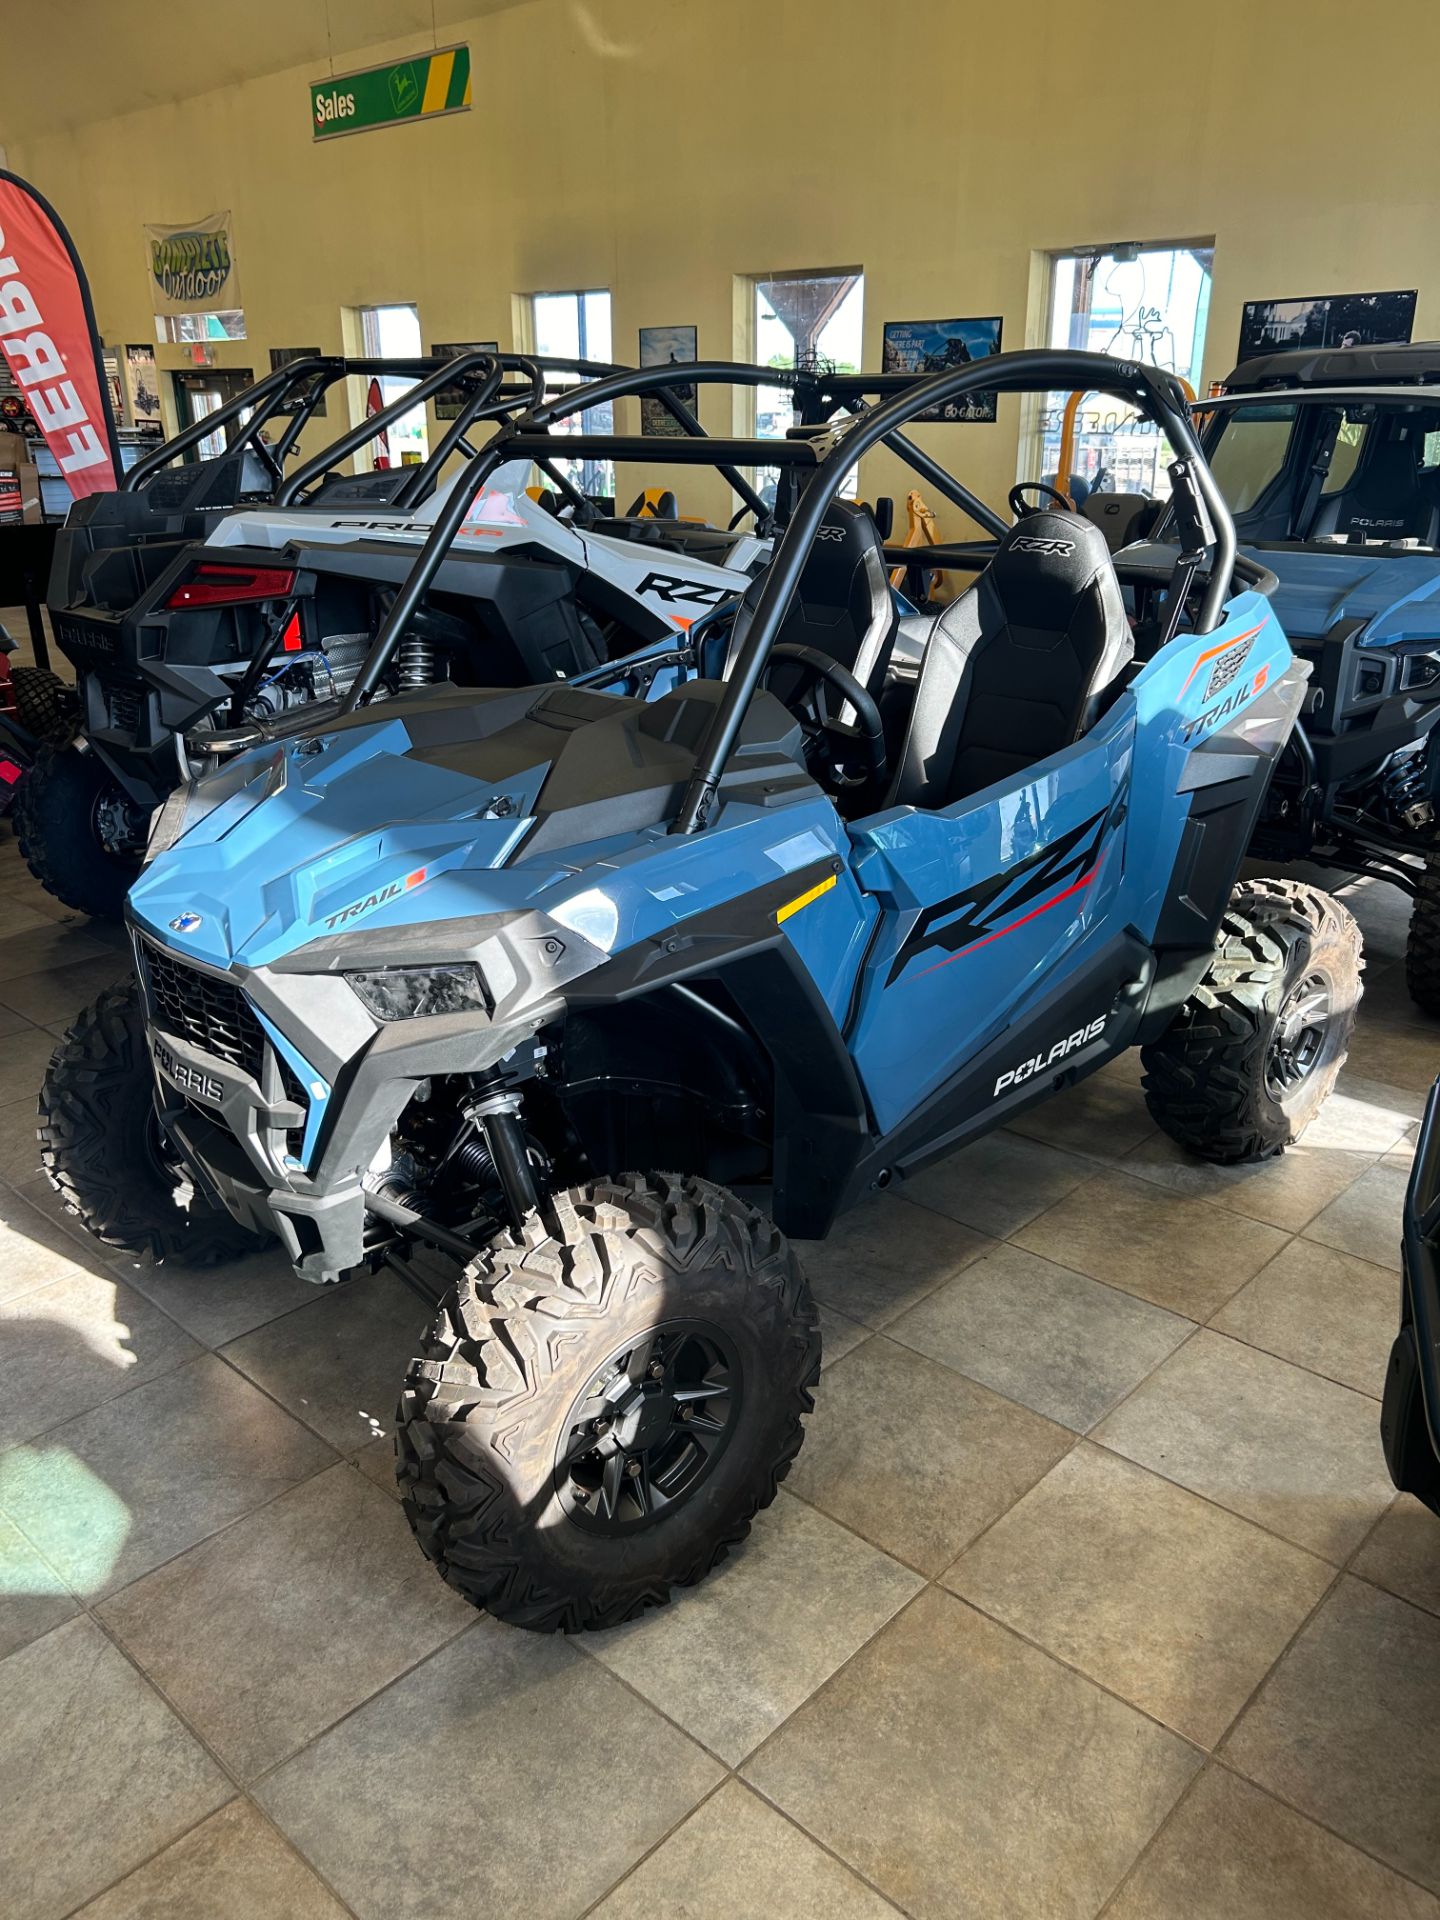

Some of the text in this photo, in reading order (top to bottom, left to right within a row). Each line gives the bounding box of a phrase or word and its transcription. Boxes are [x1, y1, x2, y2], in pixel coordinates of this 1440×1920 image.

[316, 91, 355, 122] Sales
[152, 230, 228, 274] COMPLETE
[163, 264, 226, 300] Outdoor
[944, 406, 957, 417] GO
[815, 525, 847, 541] ZR
[1350, 517, 1404, 527] POLARIS
[1008, 536, 1076, 557] RZR
[154, 1038, 224, 1102] POLARIS
[993, 1013, 1107, 1097] POLARIS
